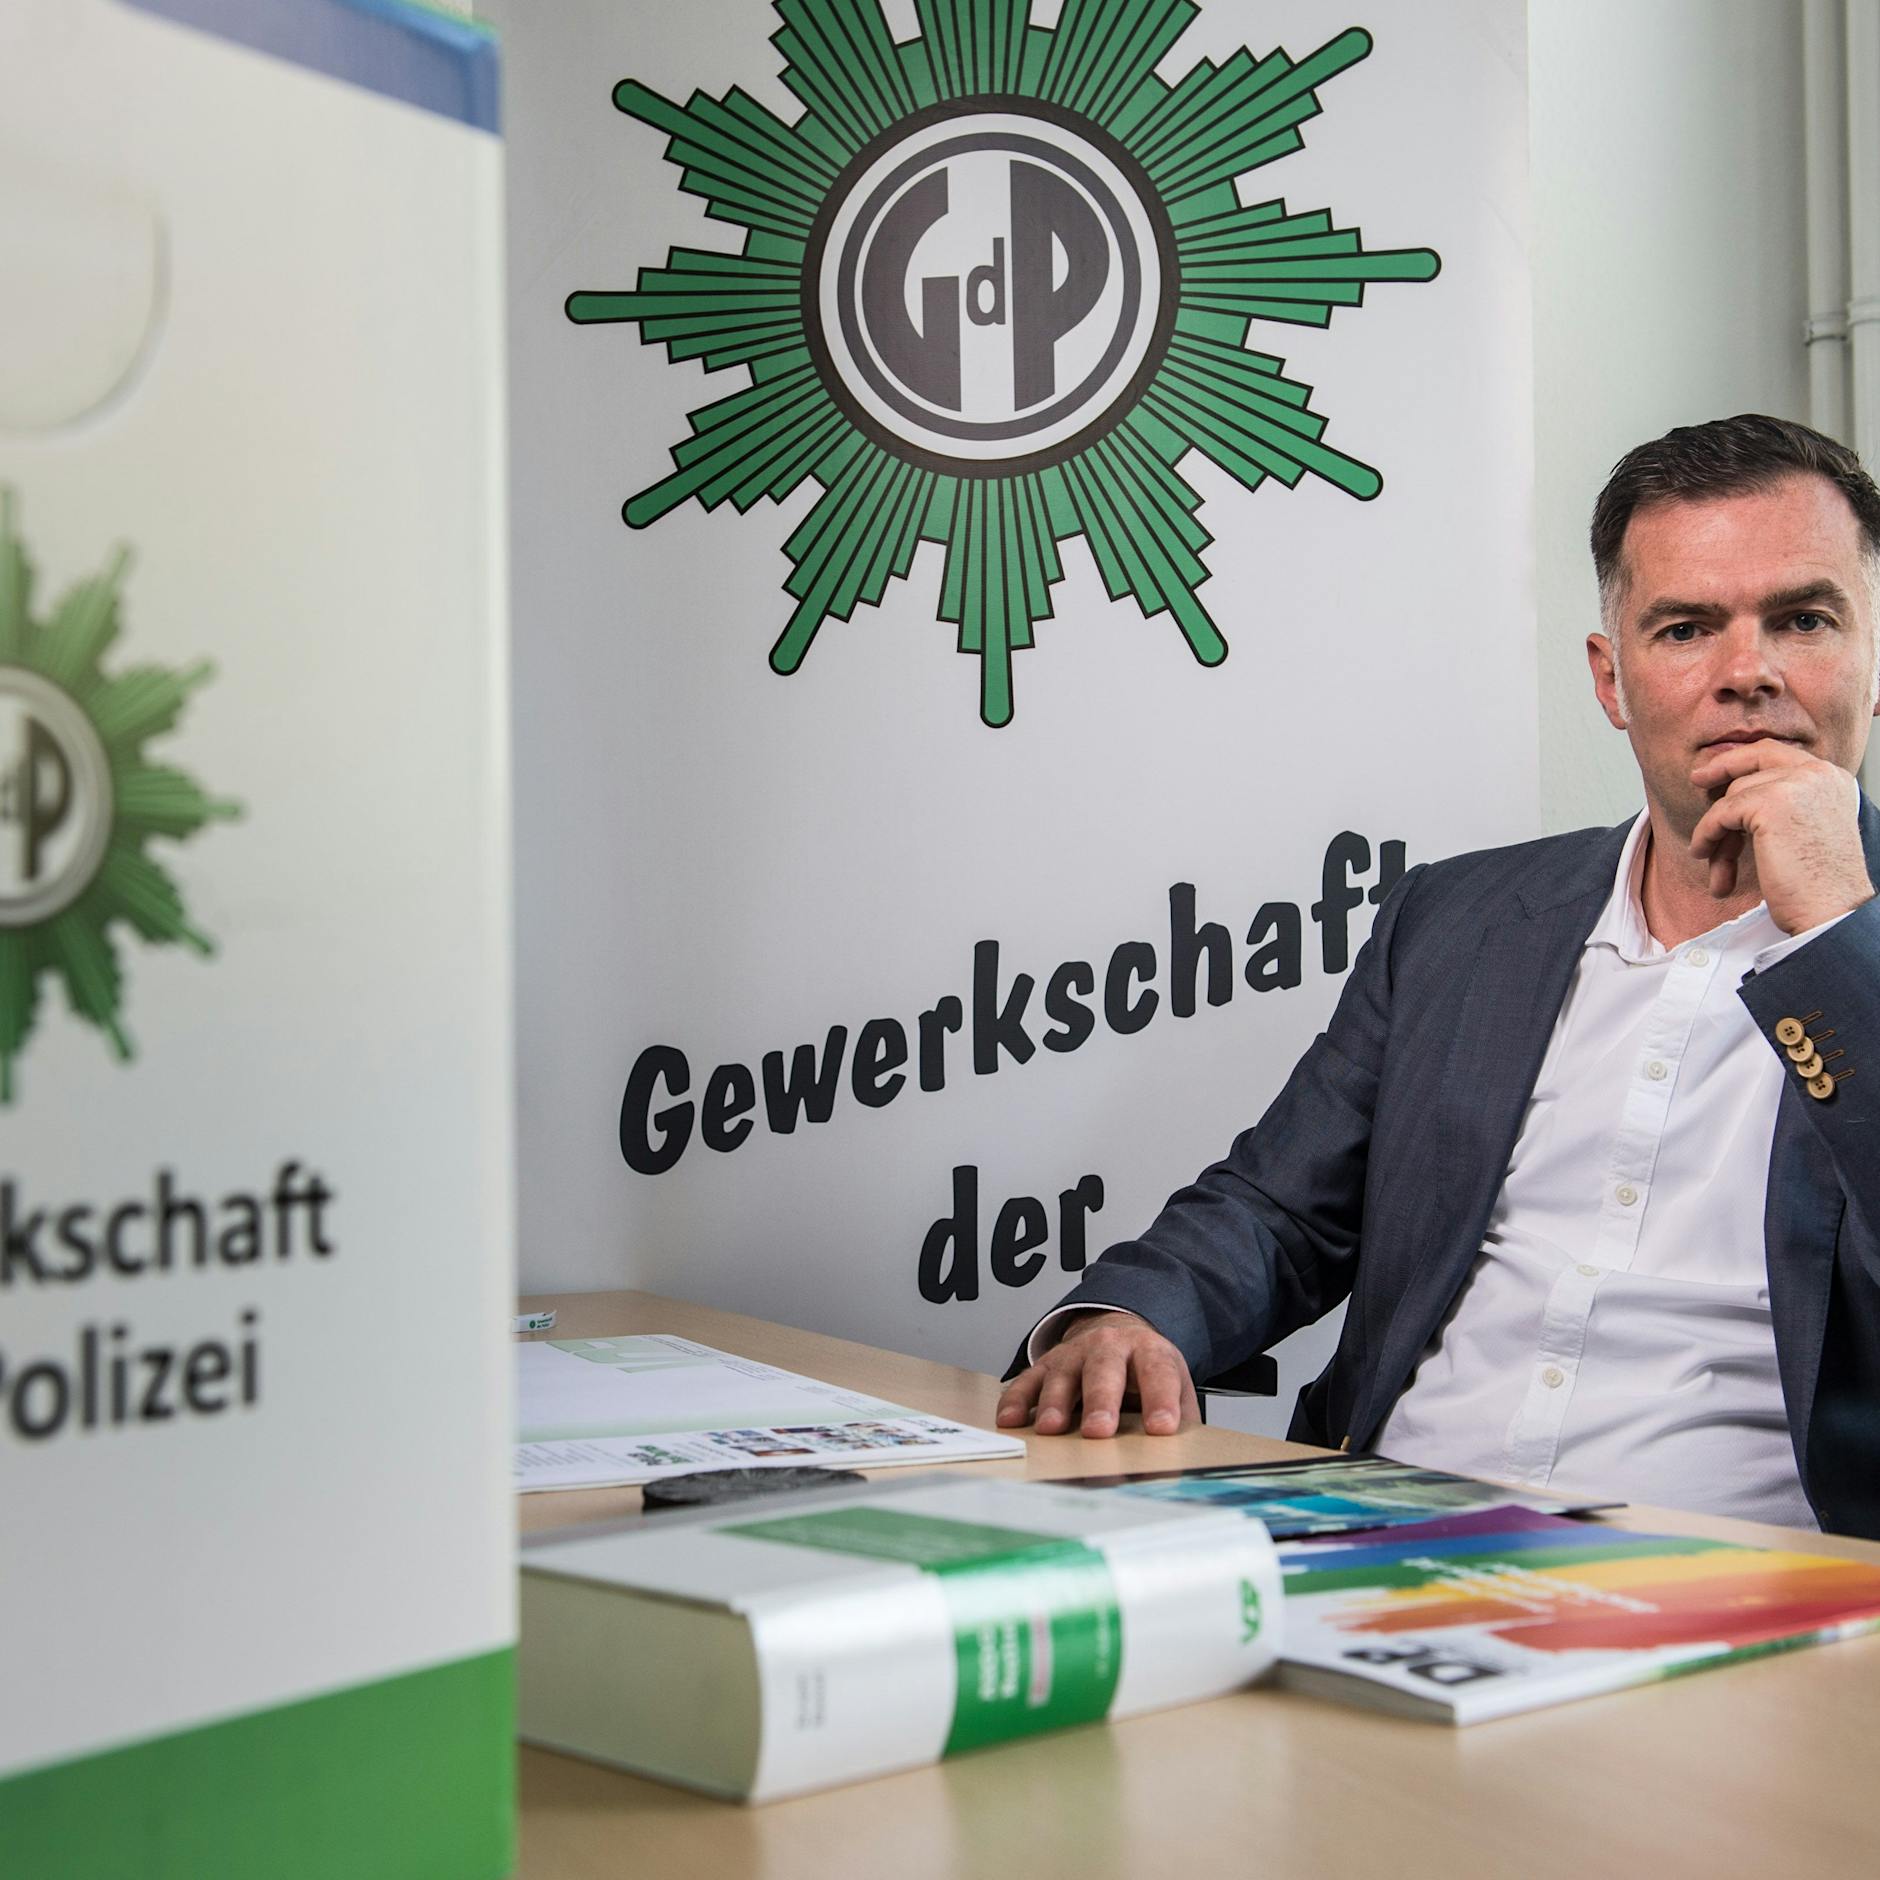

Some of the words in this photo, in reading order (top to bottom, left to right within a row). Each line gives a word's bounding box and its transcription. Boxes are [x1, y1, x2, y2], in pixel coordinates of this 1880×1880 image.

[861, 158, 1111, 413] GdP
[918, 1165, 1104, 1304] der
[0, 1309, 258, 1440] olizei
